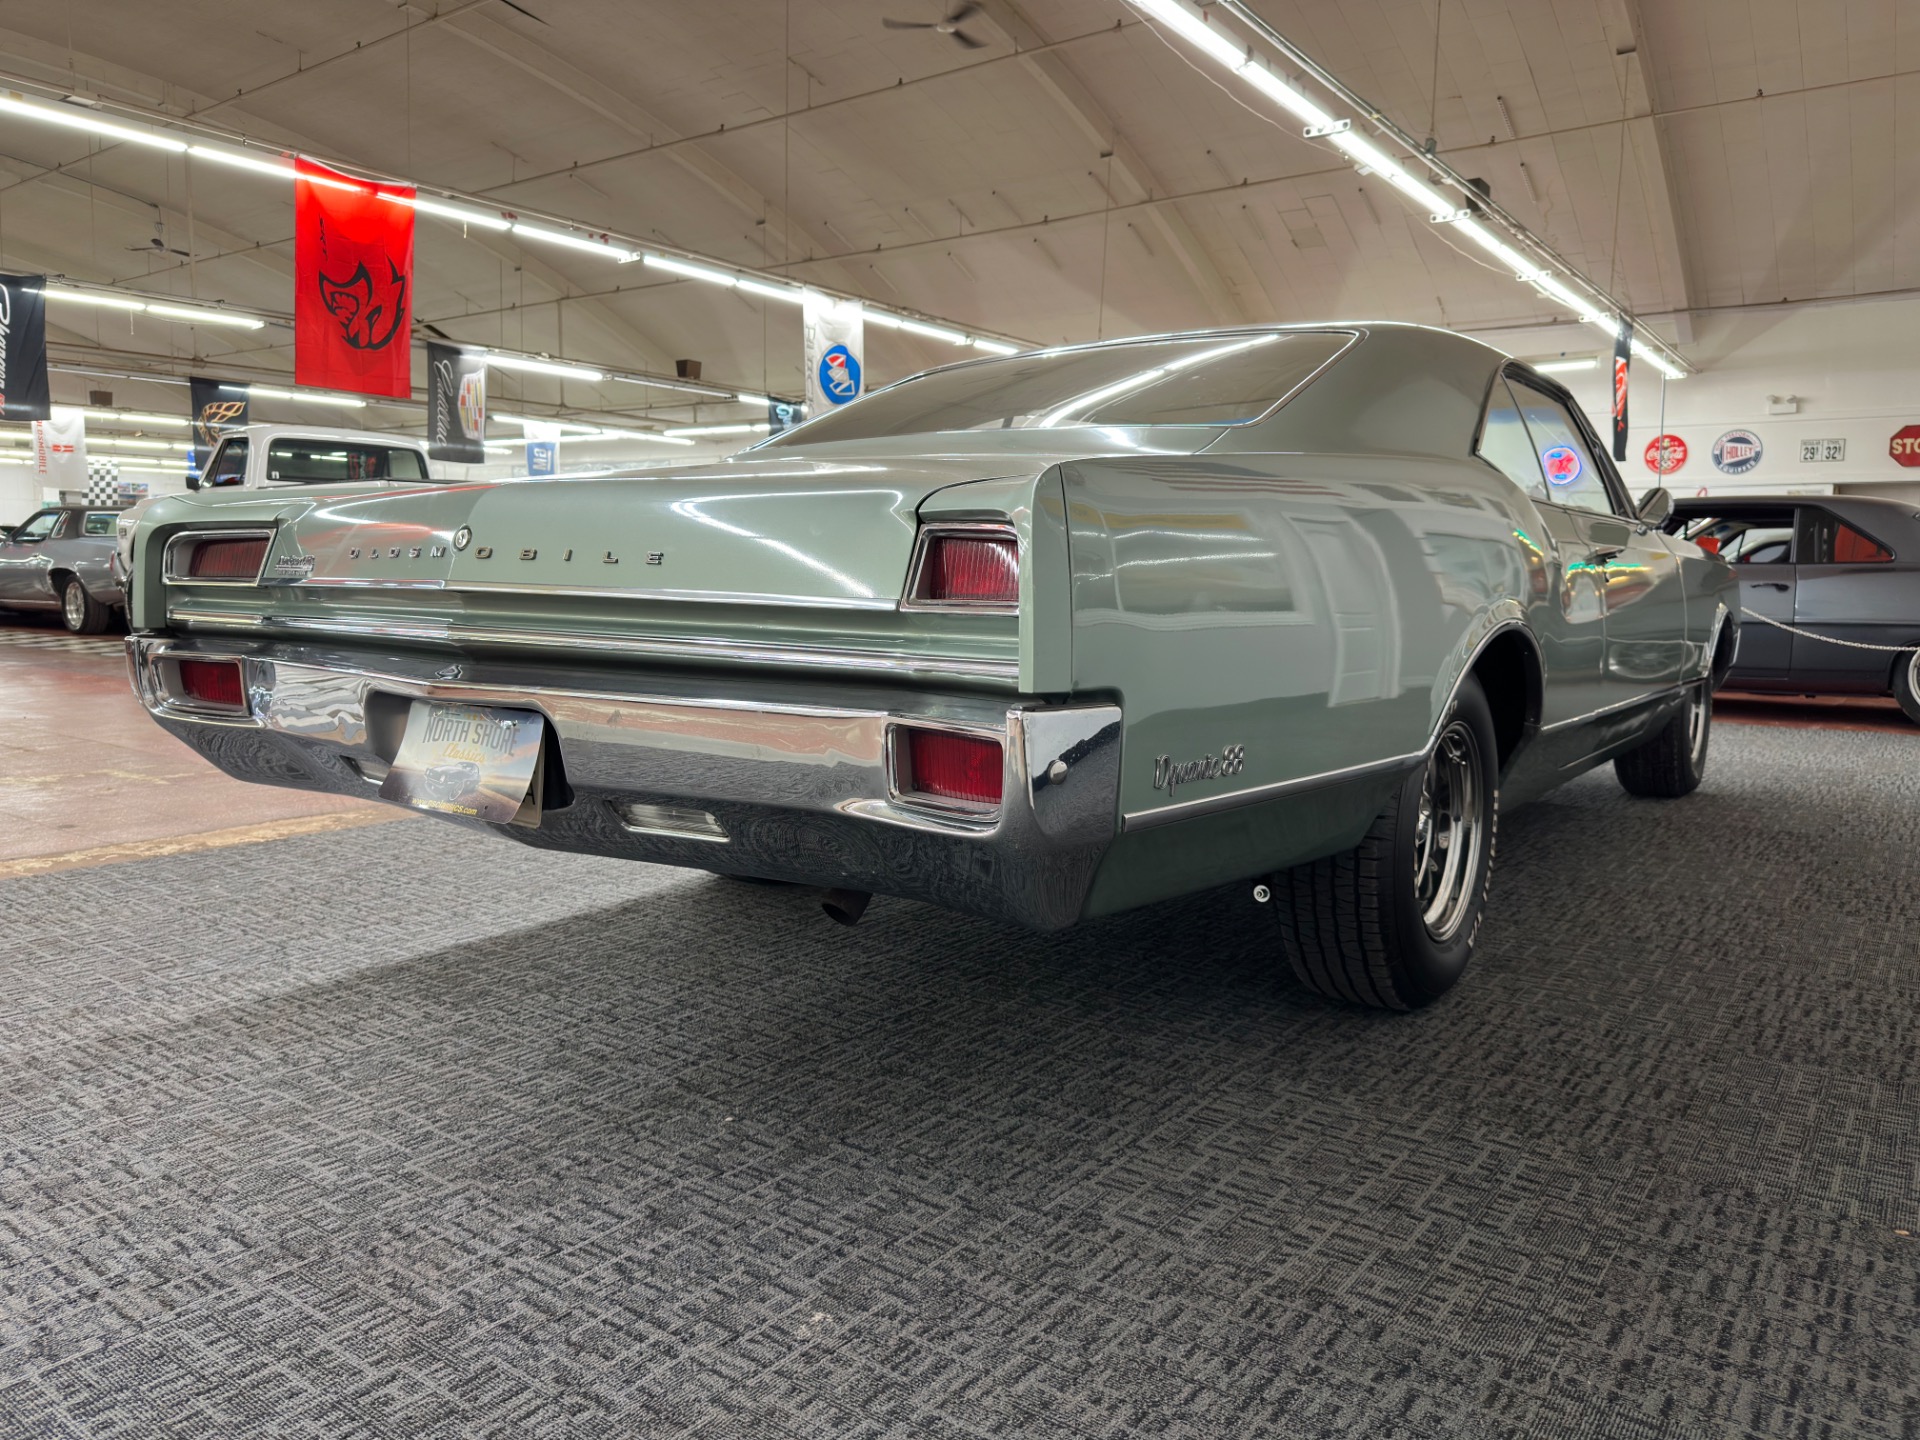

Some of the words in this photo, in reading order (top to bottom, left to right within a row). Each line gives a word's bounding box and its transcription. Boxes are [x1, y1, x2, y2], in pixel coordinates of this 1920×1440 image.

[433, 359, 453, 447] Cadillac
[1726, 445, 1754, 461] HOLLEY
[349, 545, 665, 566] OLDSMOBILE
[422, 715, 472, 744] NORTH
[472, 723, 521, 757] SHORE
[1154, 754, 1221, 797] Dynamic
[1221, 743, 1245, 776] 88
